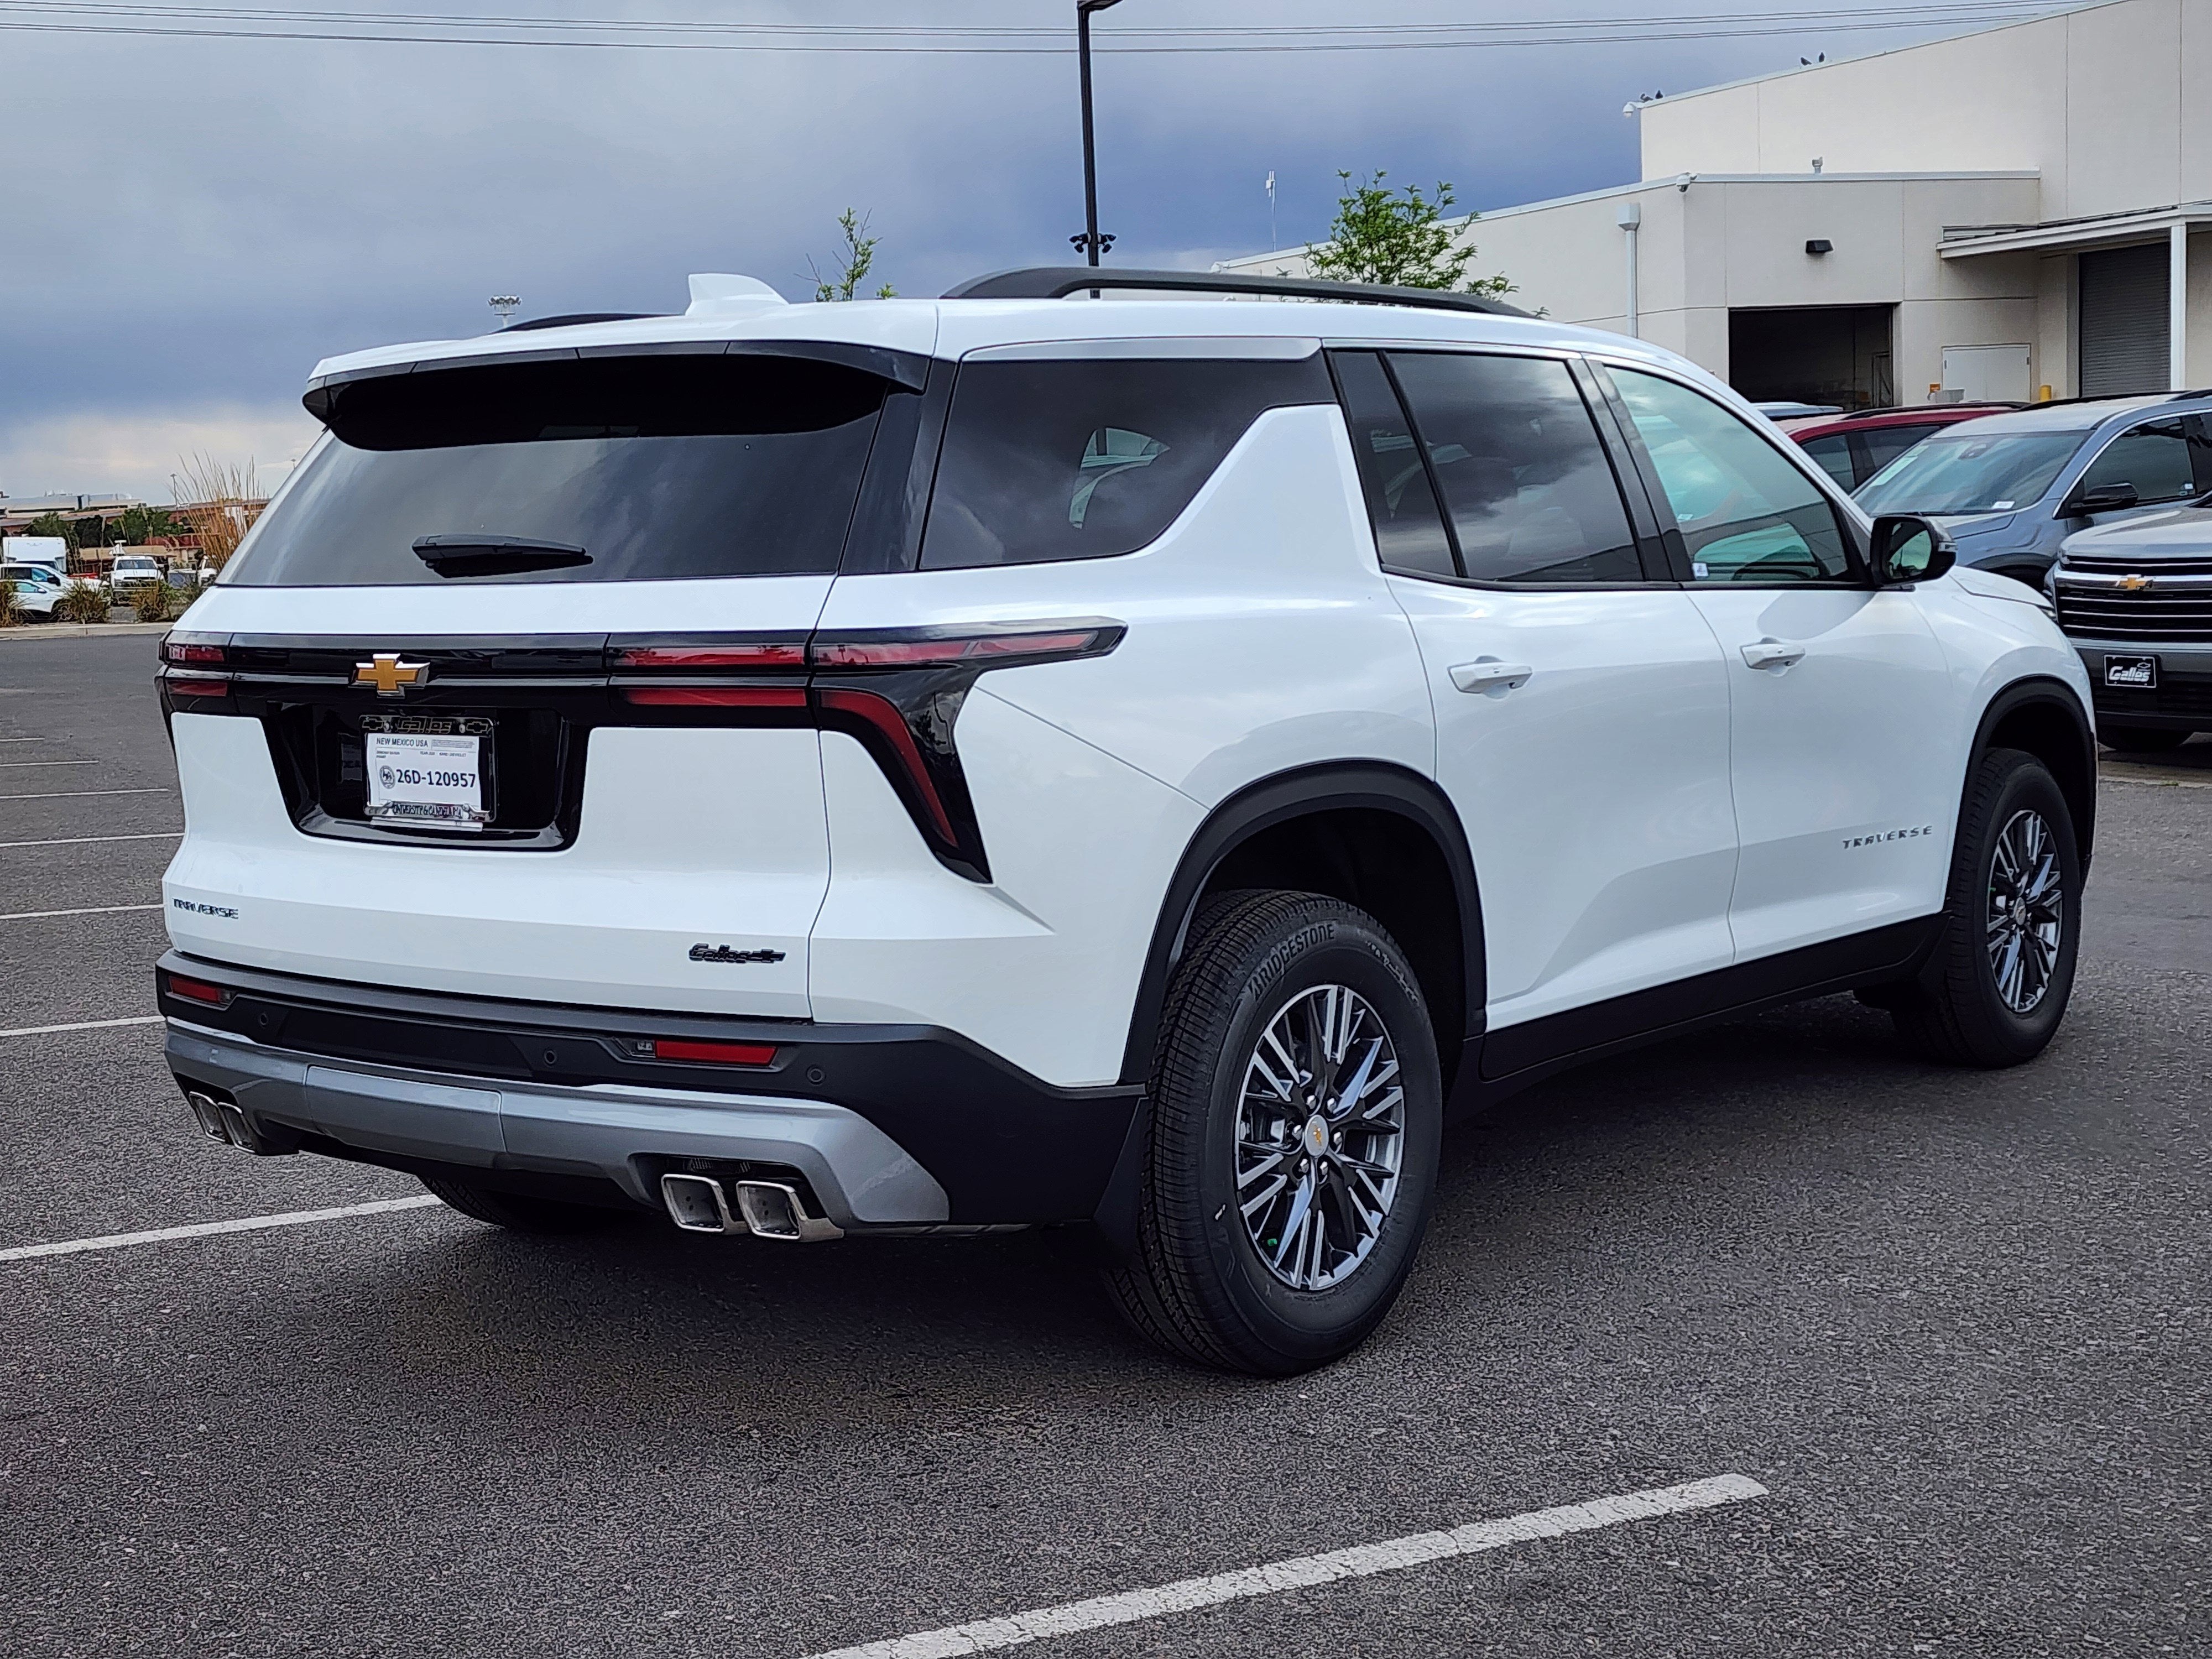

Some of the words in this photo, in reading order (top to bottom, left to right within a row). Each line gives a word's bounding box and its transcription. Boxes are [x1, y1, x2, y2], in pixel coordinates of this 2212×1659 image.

[2109, 666, 2151, 682] Galles
[392, 738, 414, 747] MEXICO
[396, 769, 476, 788] 26D-120957
[1843, 826, 1932, 849] TRAVERSE
[172, 898, 239, 919] TRAVERSE
[1248, 923, 1334, 1001] BRIDGESTONE
